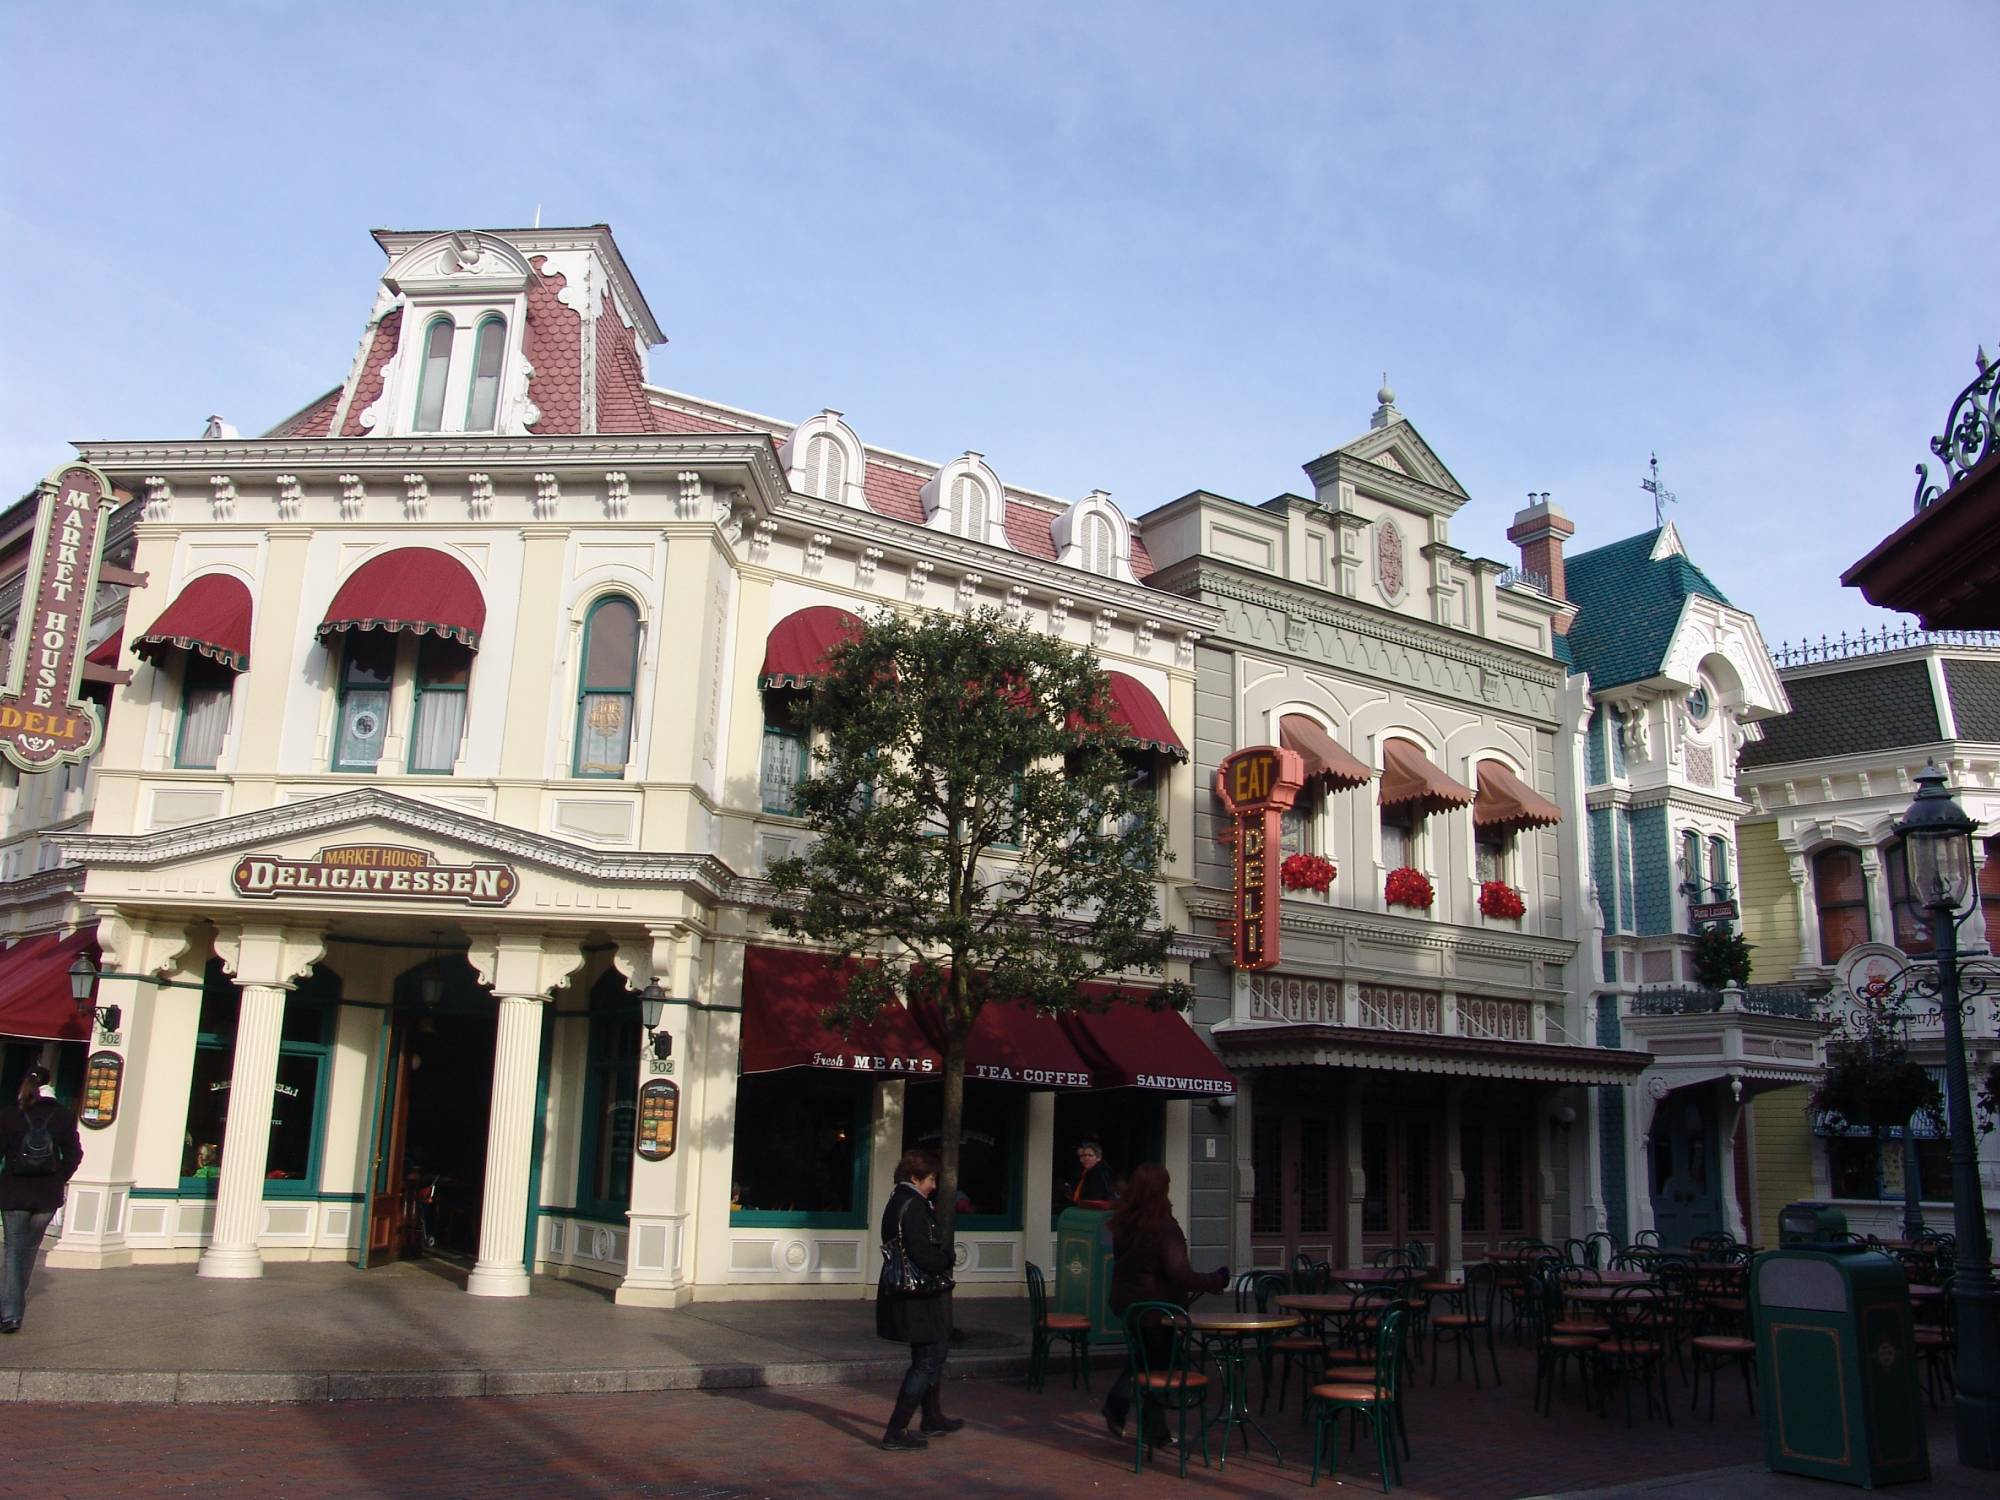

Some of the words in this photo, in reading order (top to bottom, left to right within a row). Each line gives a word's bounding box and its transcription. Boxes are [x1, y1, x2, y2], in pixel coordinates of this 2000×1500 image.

[53, 491, 90, 601] MARKET
[34, 612, 69, 708] HOUSE
[1, 706, 77, 739] DELI
[1235, 757, 1272, 802] EAT
[325, 849, 380, 867] MARKET
[382, 849, 426, 868] HOUSE
[247, 862, 501, 897] DELICATESSEN
[1244, 828, 1265, 953] DELI
[99, 1033, 120, 1045] 302
[651, 1061, 673, 1073] 302
[812, 1051, 844, 1068] Fresh
[853, 1055, 934, 1073] MEATS
[976, 1064, 1013, 1081] TEA
[1023, 1068, 1089, 1086] COFFEE
[1136, 1075, 1233, 1093] SANDWICHES
